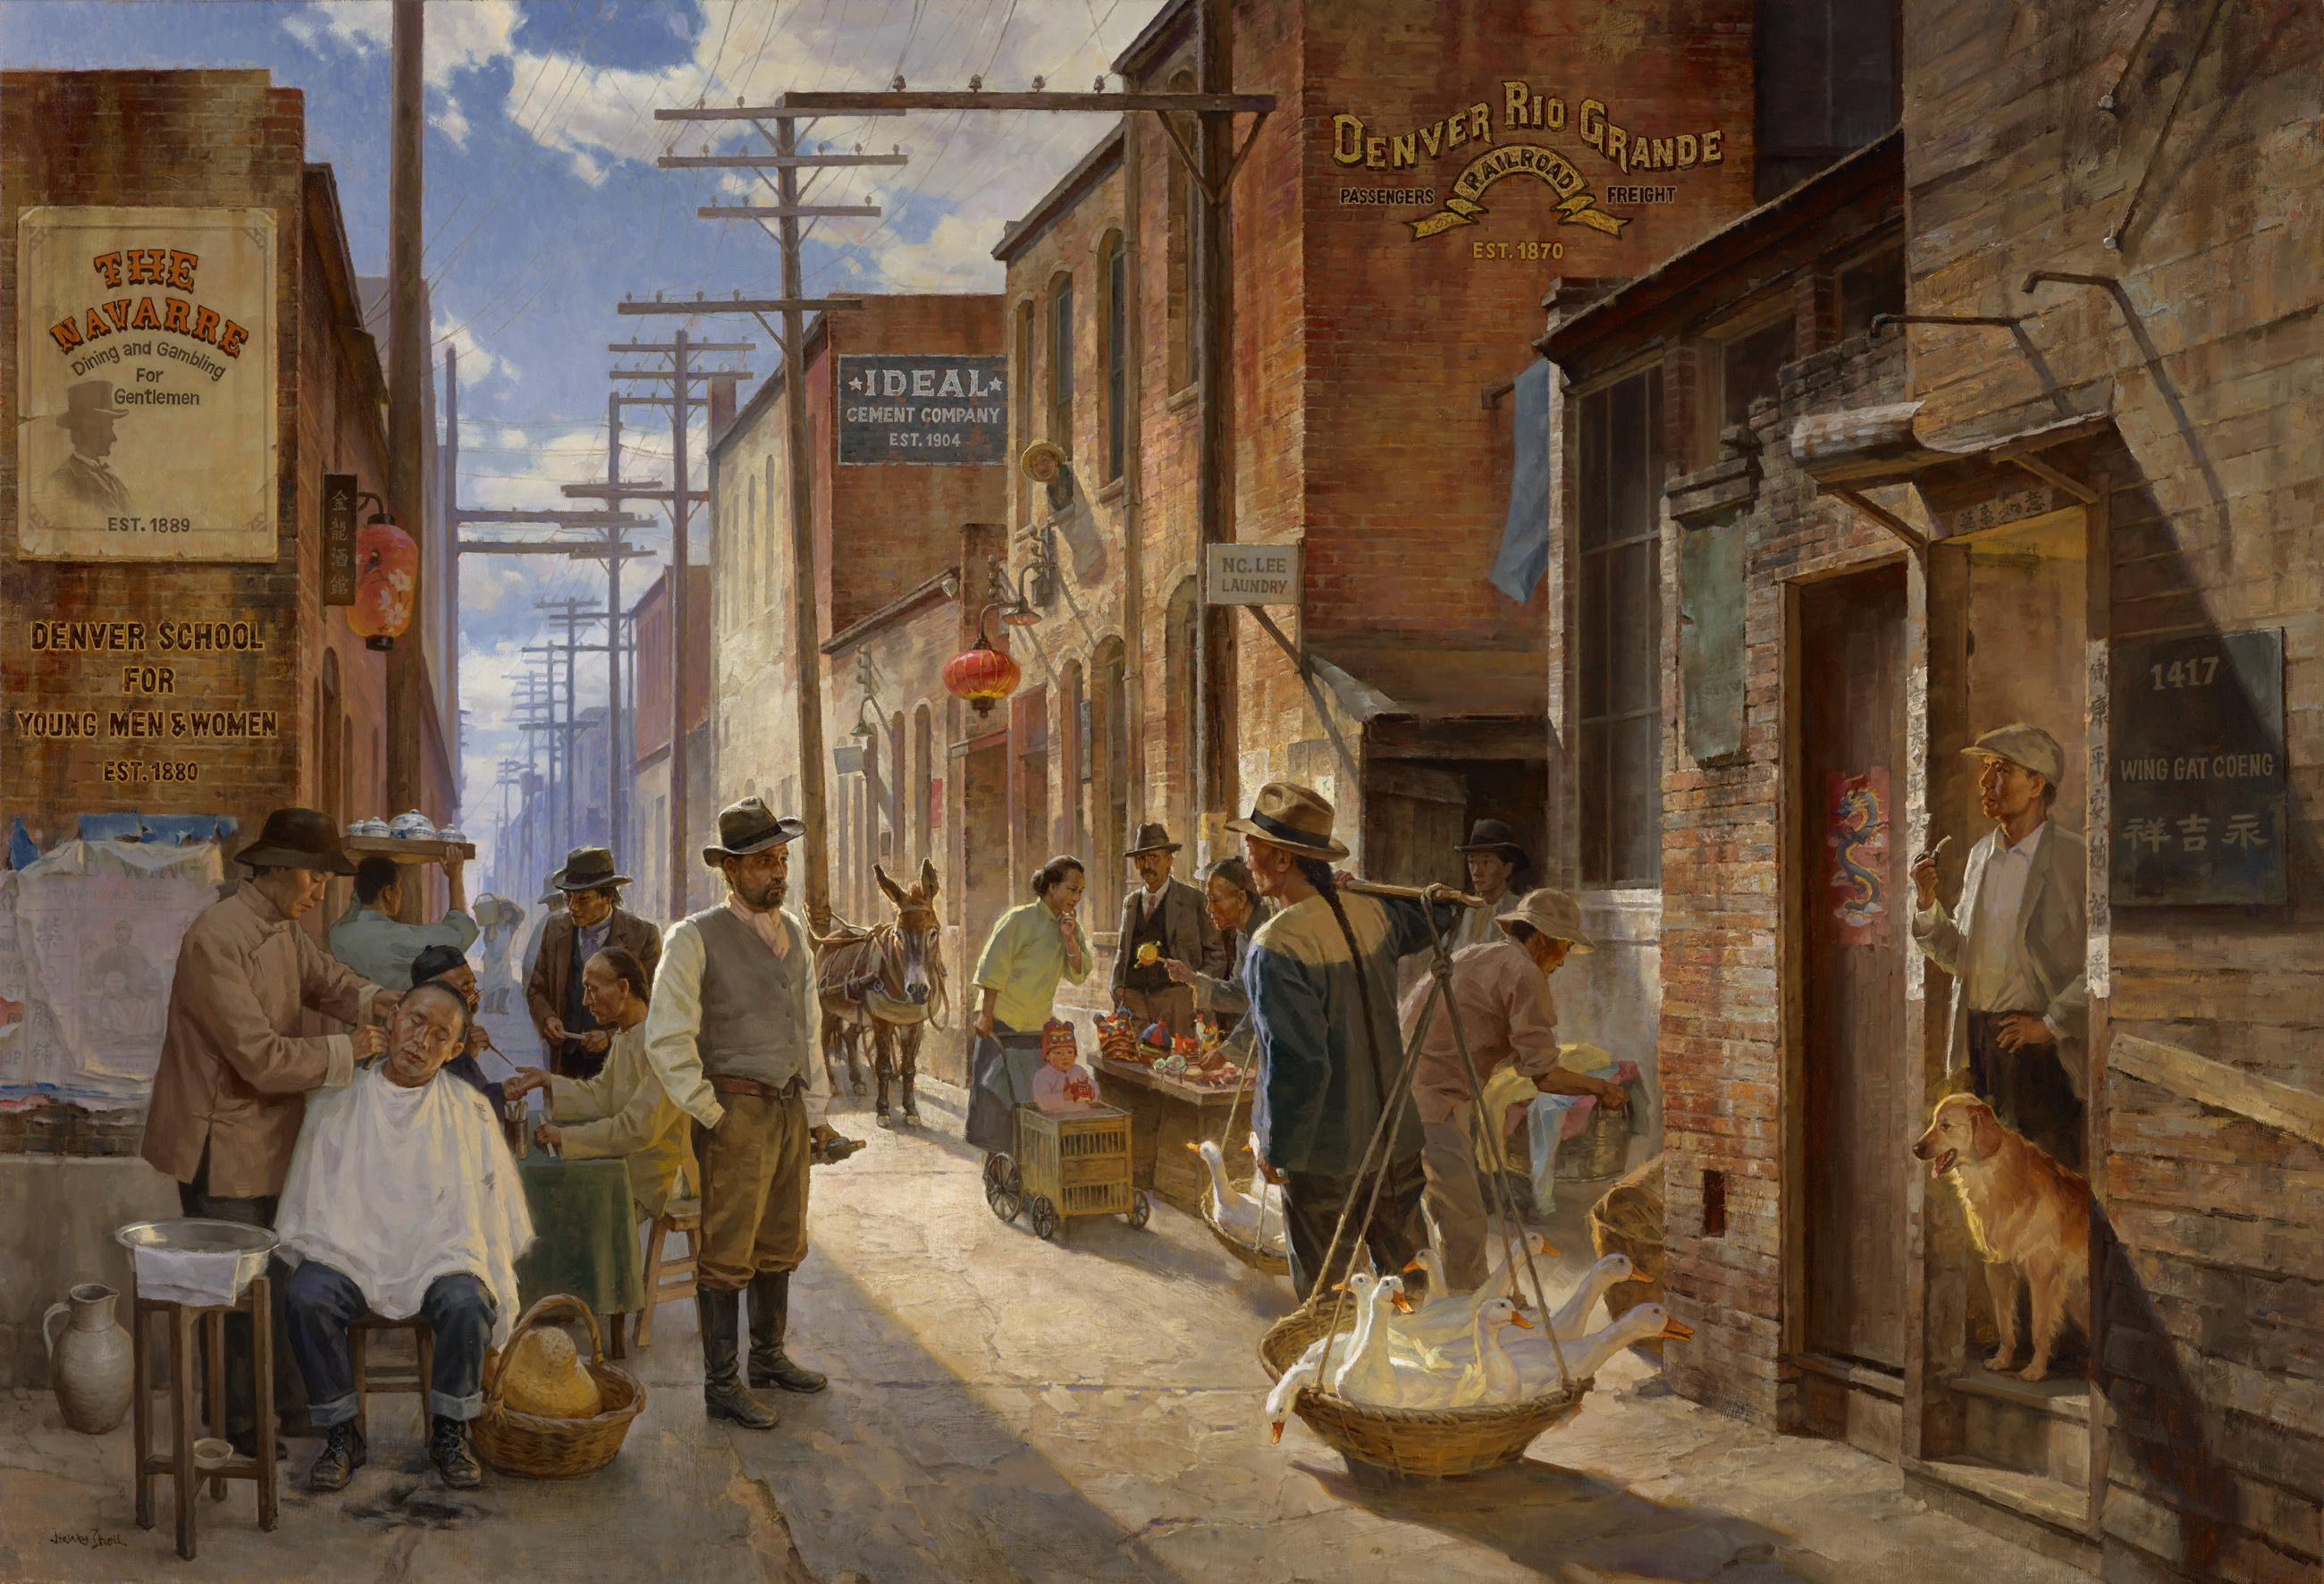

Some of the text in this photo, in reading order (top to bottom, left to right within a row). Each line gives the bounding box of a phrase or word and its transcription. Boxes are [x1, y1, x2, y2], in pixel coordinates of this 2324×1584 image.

[1330, 100, 1495, 170] DENVER
[1579, 97, 1725, 176] GRANDE
[1467, 148, 1577, 192] RAILROAD
[1339, 186, 1436, 206] PASSENGERS
[1606, 185, 1677, 204] FREIGHT
[1472, 241, 1564, 261] EST. 1870
[94, 249, 198, 293] THE
[49, 297, 250, 359] NAVARRE
[71, 341, 227, 382] Dining and Gambling
[135, 367, 164, 383] For
[114, 388, 200, 406] Gentlemen
[864, 368, 989, 398] IDEAL
[846, 406, 1000, 424] CEMENT COMPANY
[889, 433, 961, 447] EST. 1904
[107, 517, 191, 533] EST. 1889
[1222, 577, 1288, 594] LAUNDRY
[30, 620, 265, 651] DENVER SCHOOL
[122, 666, 176, 695] FOR
[2150, 656, 2219, 690] 1417
[17, 710, 278, 739] YOUNG MEN & WOMEN
[103, 761, 198, 783] EST. 1880
[2119, 753, 2274, 781] WING GAT COENG
